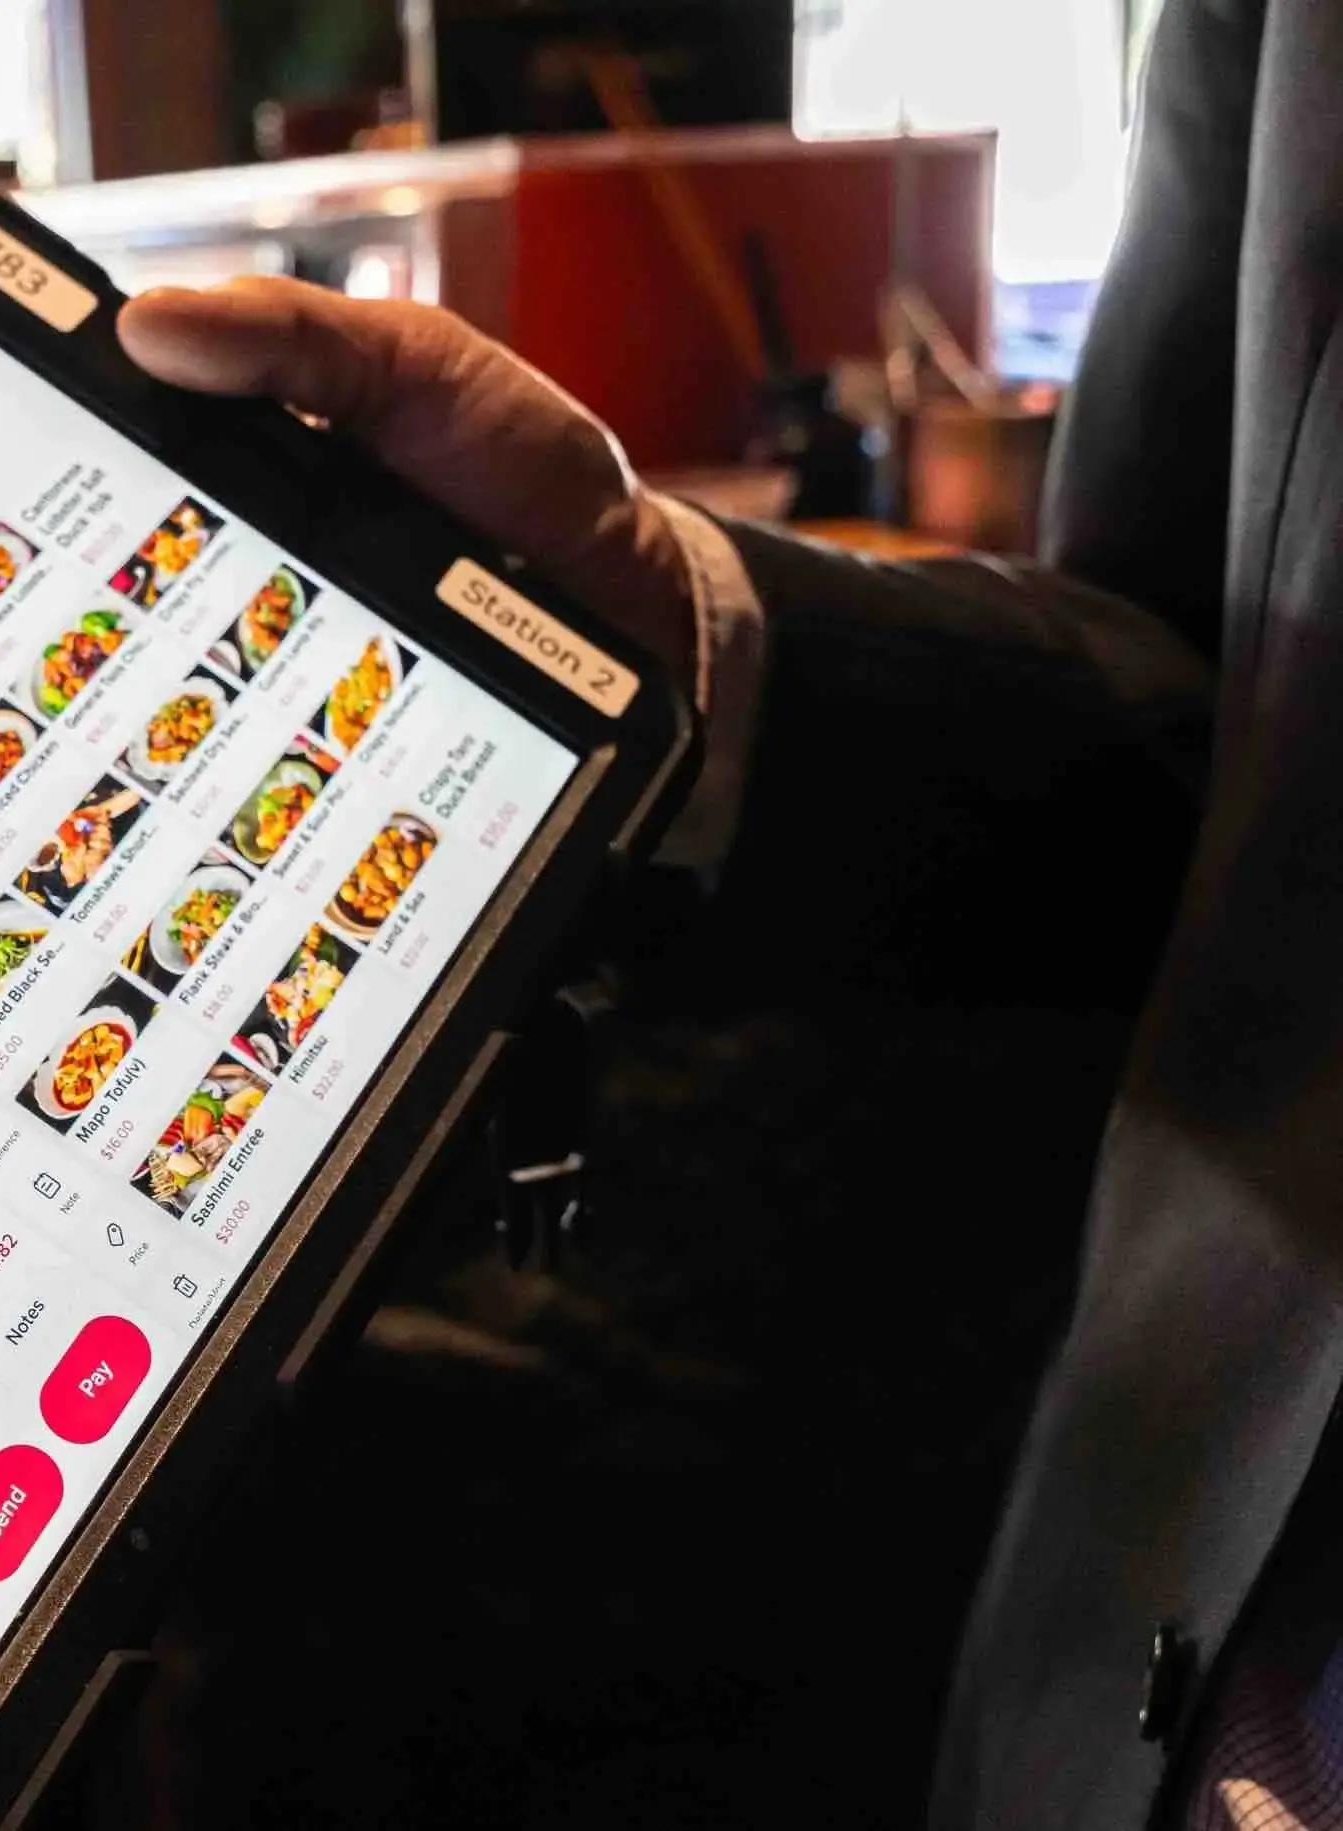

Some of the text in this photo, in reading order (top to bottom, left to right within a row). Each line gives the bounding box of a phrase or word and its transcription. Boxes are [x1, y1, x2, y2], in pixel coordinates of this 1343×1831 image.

[460, 579, 616, 696] Station 2
[15, 740, 59, 785] Chicken
[69, 864, 125, 924] Tomahawk
[7, 966, 42, 1003] Black
[178, 969, 210, 1005] Flank
[205, 935, 235, 970] Steak
[231, 923, 244, 935] &
[288, 1034, 328, 1084] Himitsu
[76, 1057, 147, 1144] Mapo Tofu(v)
[100, 1119, 135, 1161] $16.00
[191, 1127, 265, 1227] Sashimi Entrée
[60, 1192, 80, 1214] Note
[215, 1199, 251, 1245] $30.00
[129, 1241, 149, 1265] Price
[5, 1299, 45, 1346] Notes
[78, 1359, 115, 1399] Pay
